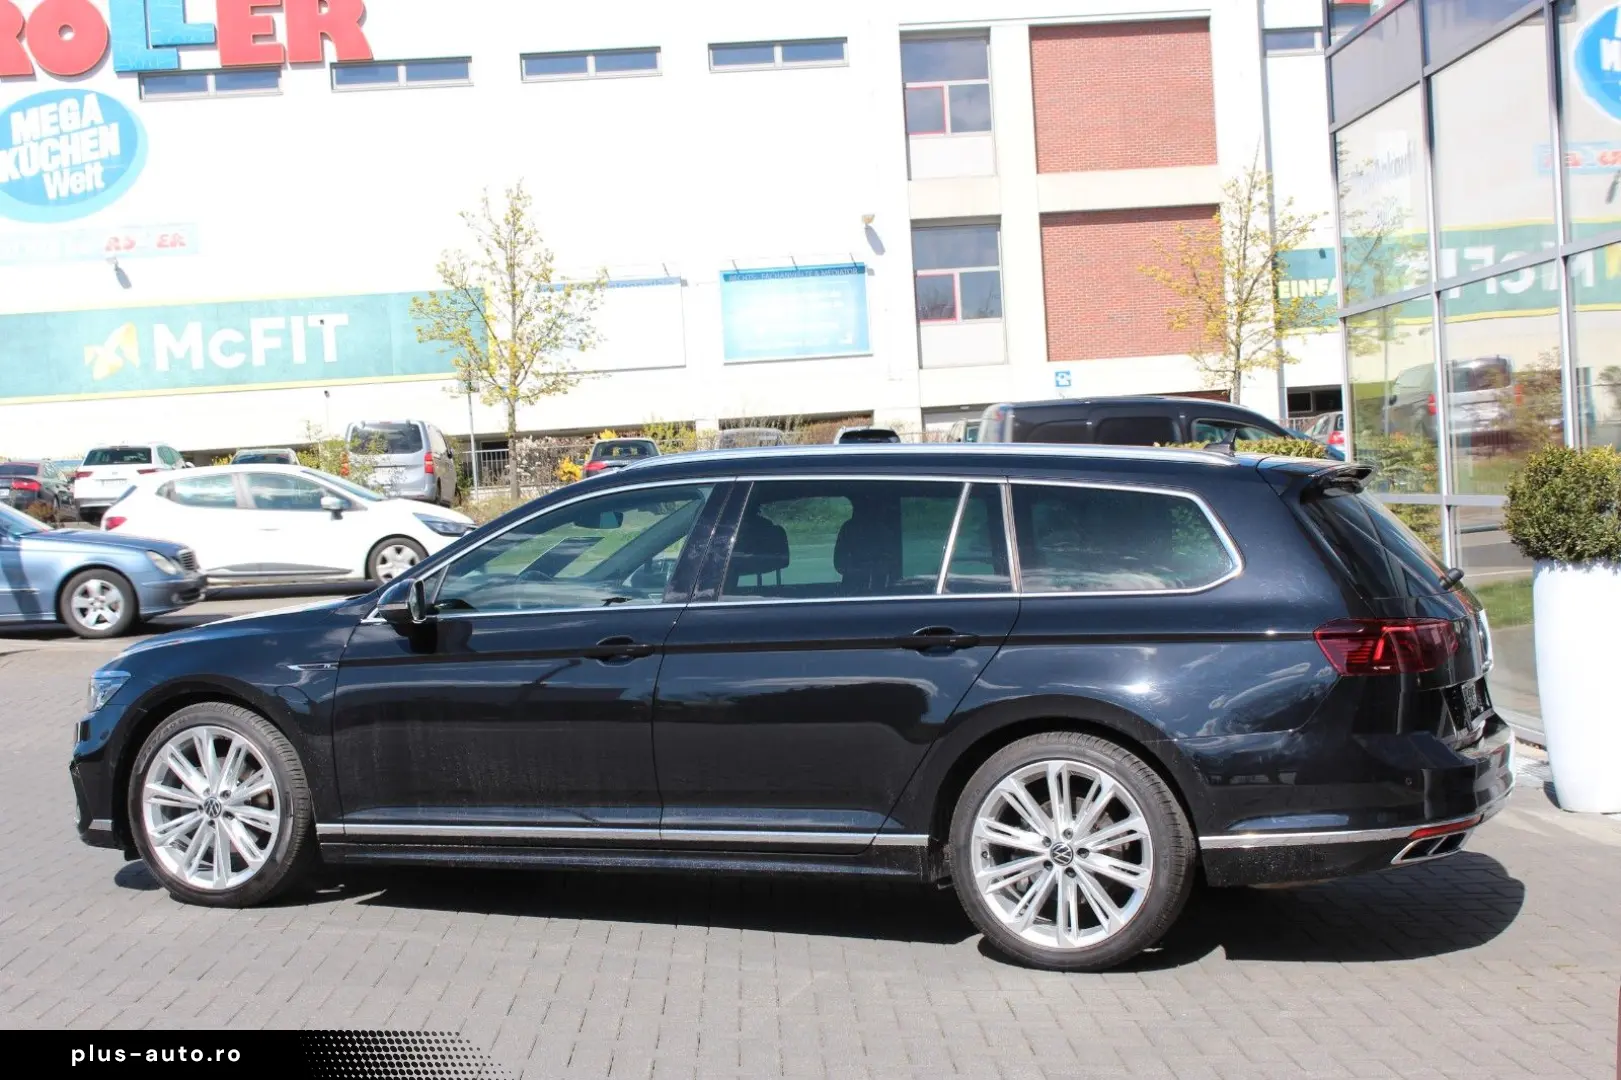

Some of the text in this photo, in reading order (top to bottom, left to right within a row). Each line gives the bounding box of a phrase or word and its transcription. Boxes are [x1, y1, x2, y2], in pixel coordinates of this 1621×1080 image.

[10, 93, 104, 145] MEGA
[43, 162, 105, 200] Welt
[153, 313, 349, 372] McFIT
